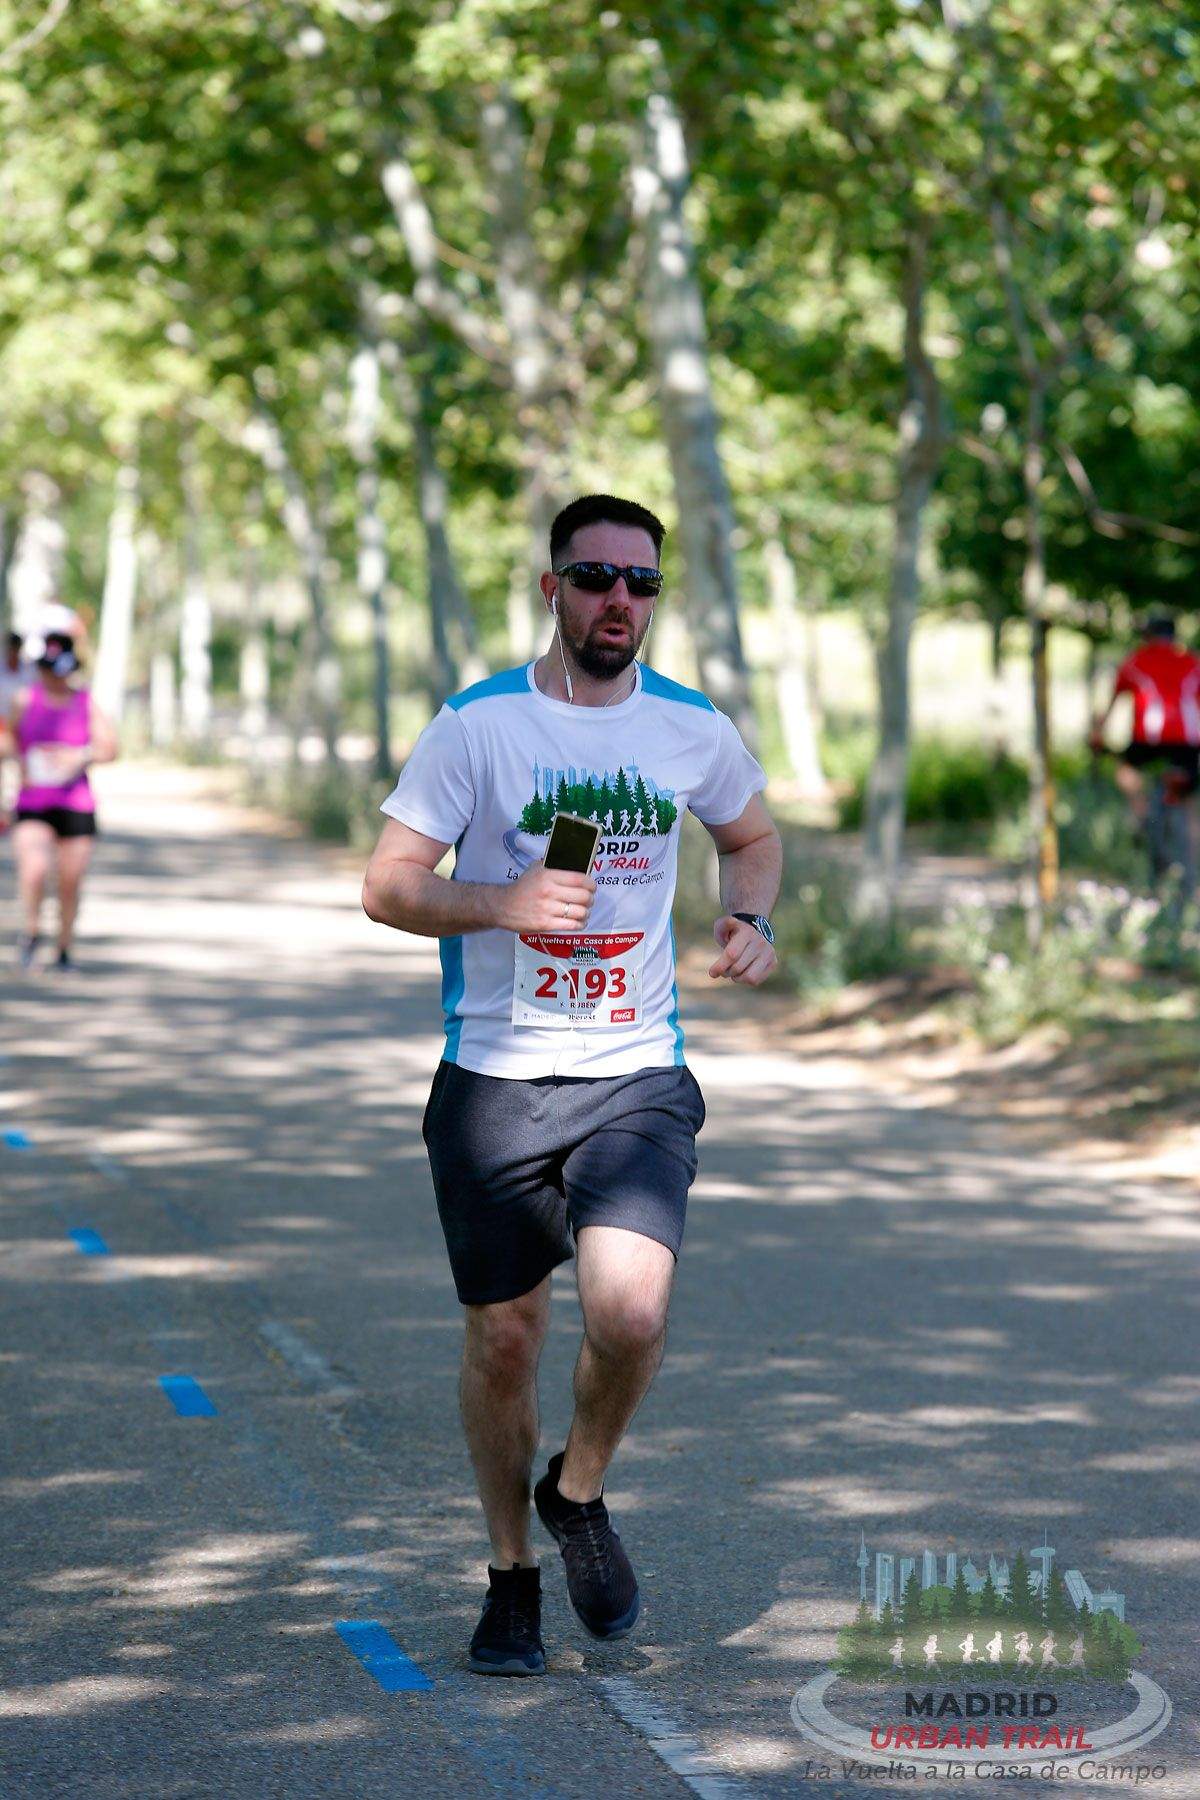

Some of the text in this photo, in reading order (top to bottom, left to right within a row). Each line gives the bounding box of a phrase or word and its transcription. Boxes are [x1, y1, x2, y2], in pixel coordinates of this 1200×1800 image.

[597, 841, 640, 855] DRID
[609, 857, 650, 870] TRAIL
[506, 868, 519, 880] La
[595, 876, 620, 885] asa
[622, 875, 638, 885] de
[572, 937, 581, 945] la
[583, 937, 603, 945] Casa
[604, 937, 614, 945] de
[614, 936, 638, 944] Campo
[534, 966, 627, 999] 2193
